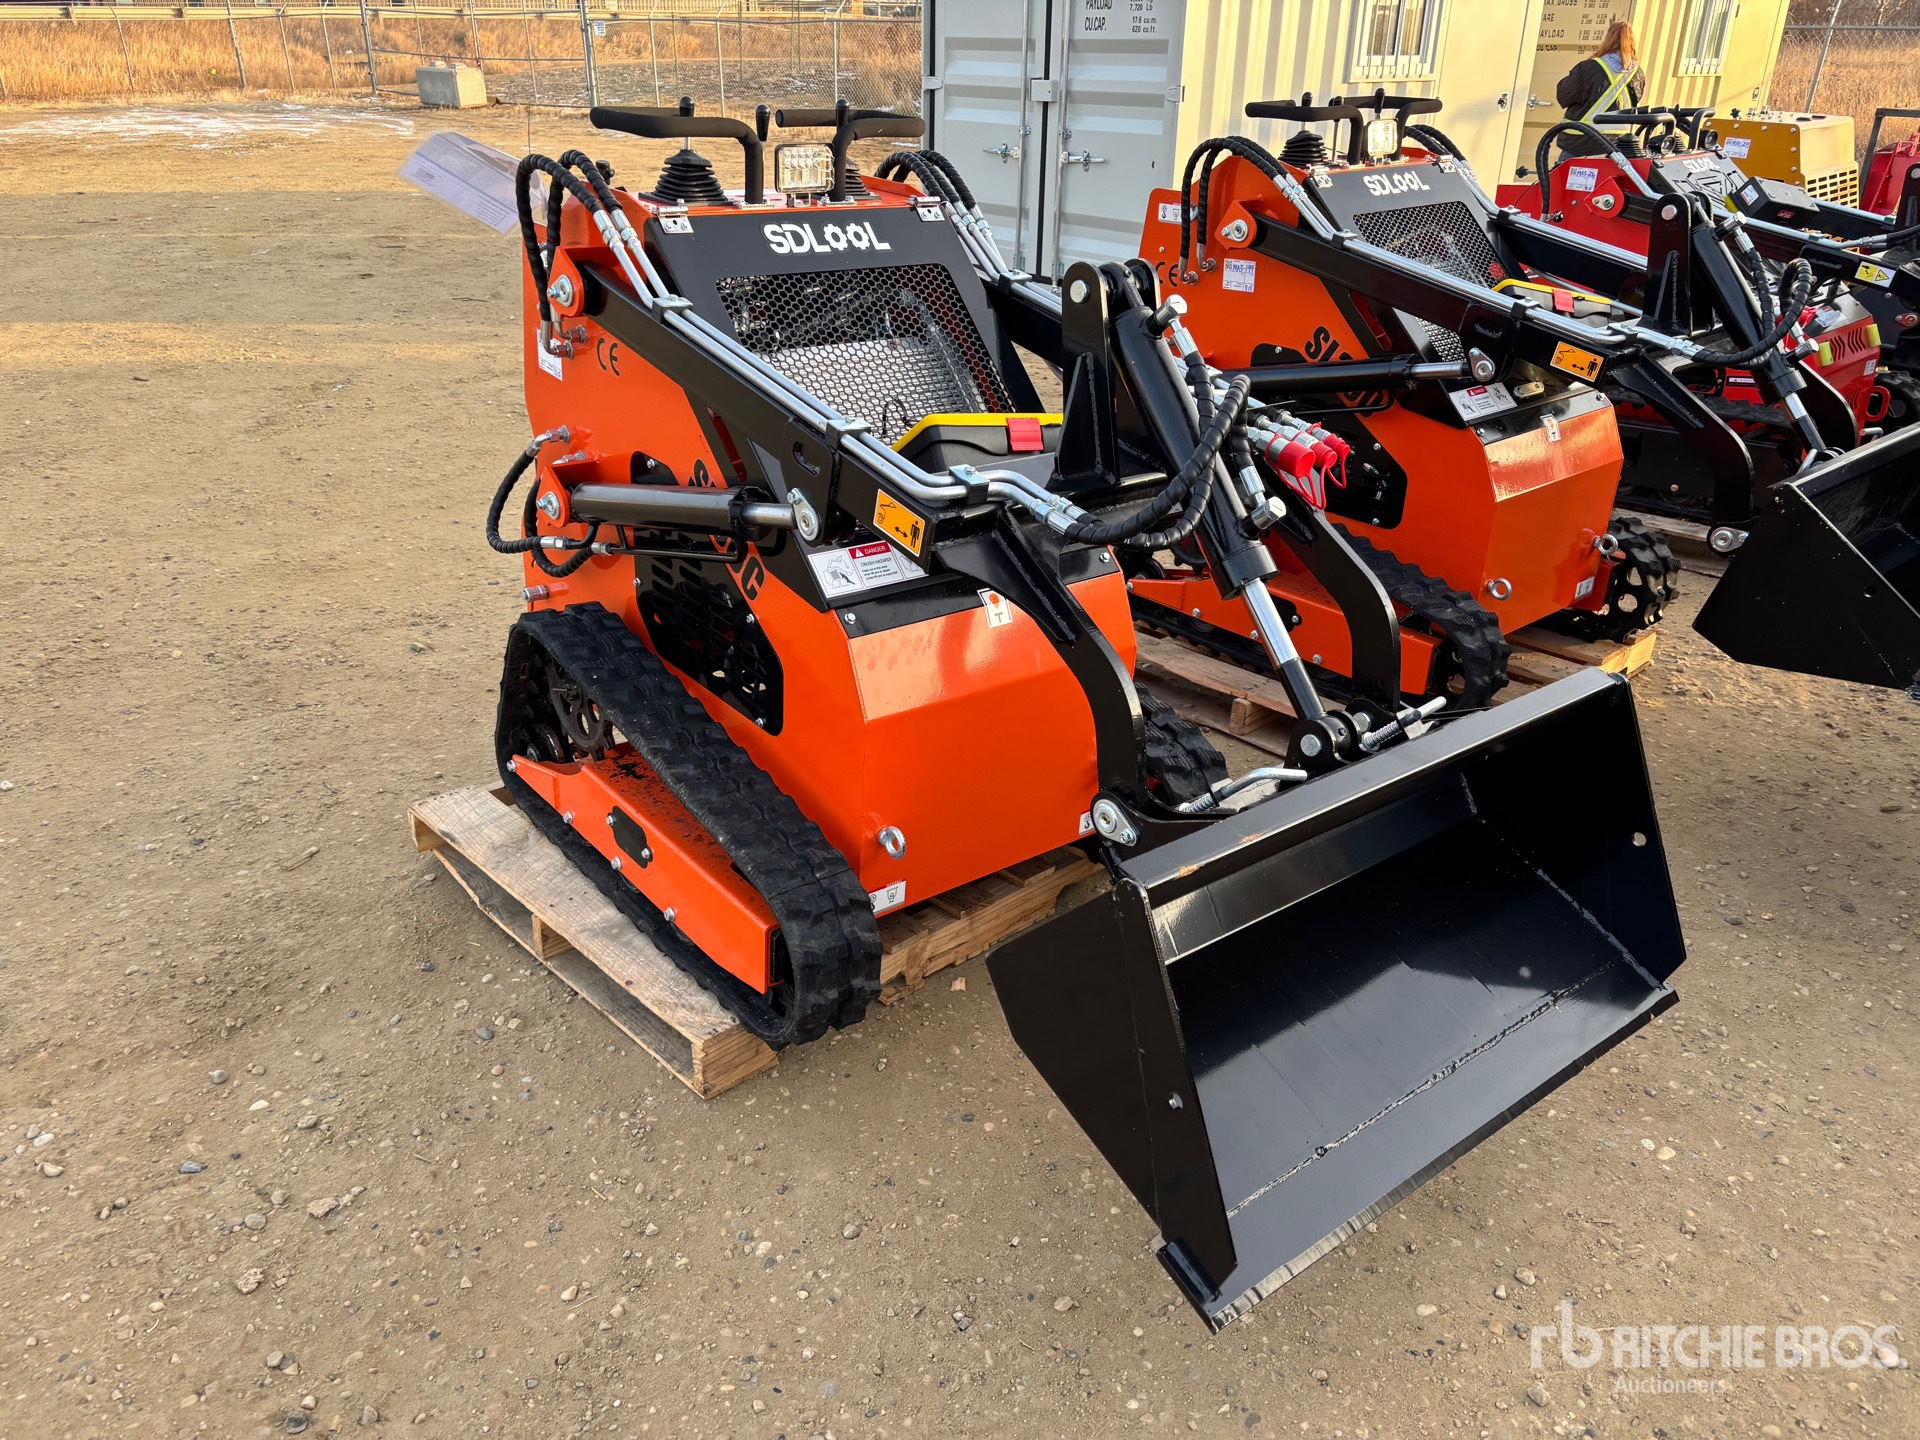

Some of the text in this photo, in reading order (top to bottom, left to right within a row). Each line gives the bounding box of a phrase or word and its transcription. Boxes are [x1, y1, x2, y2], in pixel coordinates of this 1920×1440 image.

[1084, 17, 1106, 31] CU.CAP.
[1542, 13, 1555, 22] ARE
[1540, 29, 1565, 38] AYLOAD
[1363, 171, 1431, 196] SDLOOL
[763, 221, 892, 254] SDLOOL
[597, 338, 620, 377] CE
[864, 546, 886, 554] DANGER
